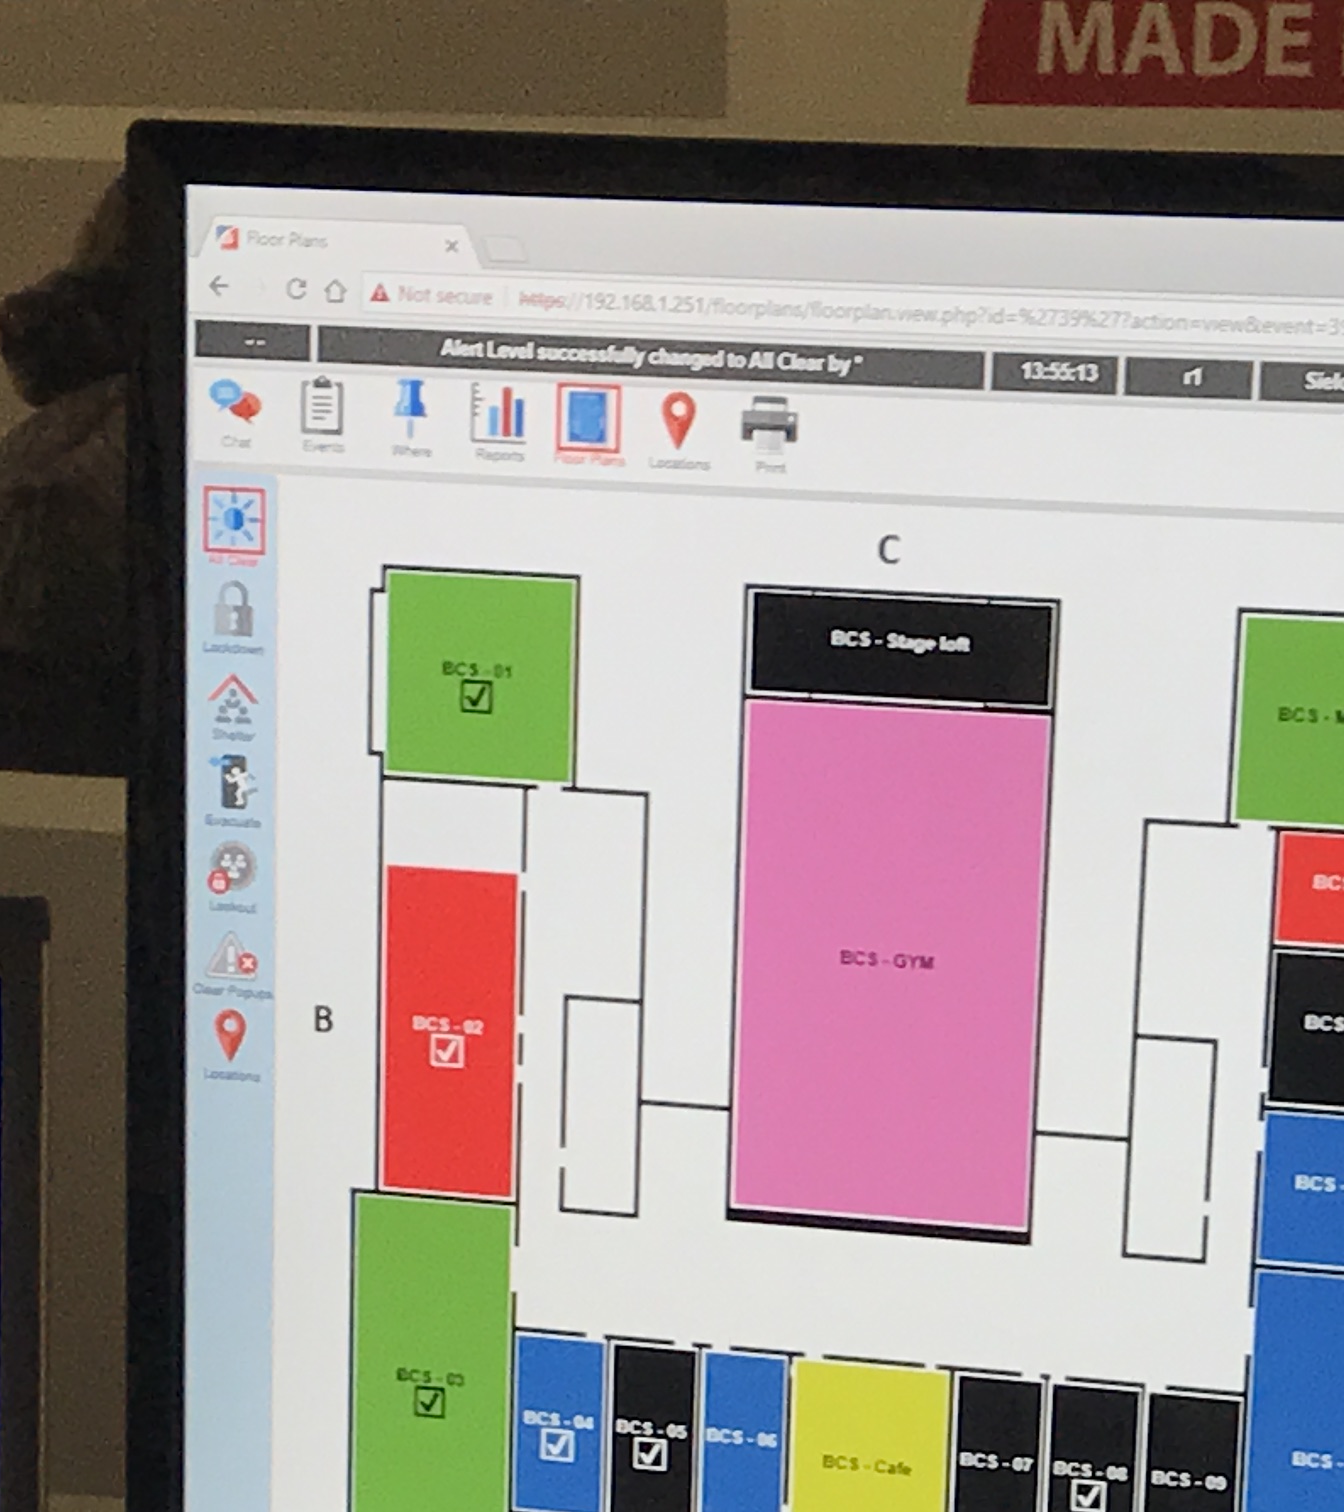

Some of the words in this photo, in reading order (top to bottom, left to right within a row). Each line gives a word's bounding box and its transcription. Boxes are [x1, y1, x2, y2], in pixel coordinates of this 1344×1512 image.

[1036, 0, 1313, 78] MADE
[440, 337, 485, 358] Alert
[486, 340, 535, 361] Level
[536, 344, 647, 371] successfully
[647, 347, 725, 373] changed
[726, 351, 747, 370] to
[747, 350, 775, 371] All
[776, 351, 826, 373] Clear
[827, 354, 852, 378] by
[1021, 360, 1099, 383] 13:55:13
[878, 534, 900, 565] C
[830, 629, 872, 648] BCS
[886, 632, 938, 654] Stage
[938, 635, 971, 653] loft
[1277, 706, 1319, 724] BCS
[839, 949, 879, 968] BCS
[893, 952, 935, 970] GYM
[314, 1004, 334, 1033] B
[412, 1014, 451, 1036] BCS
[1294, 1173, 1337, 1194] BCS
[822, 1453, 861, 1474] BCS
[873, 1457, 914, 1478] Cafe
[1291, 1450, 1333, 1471] BCS
